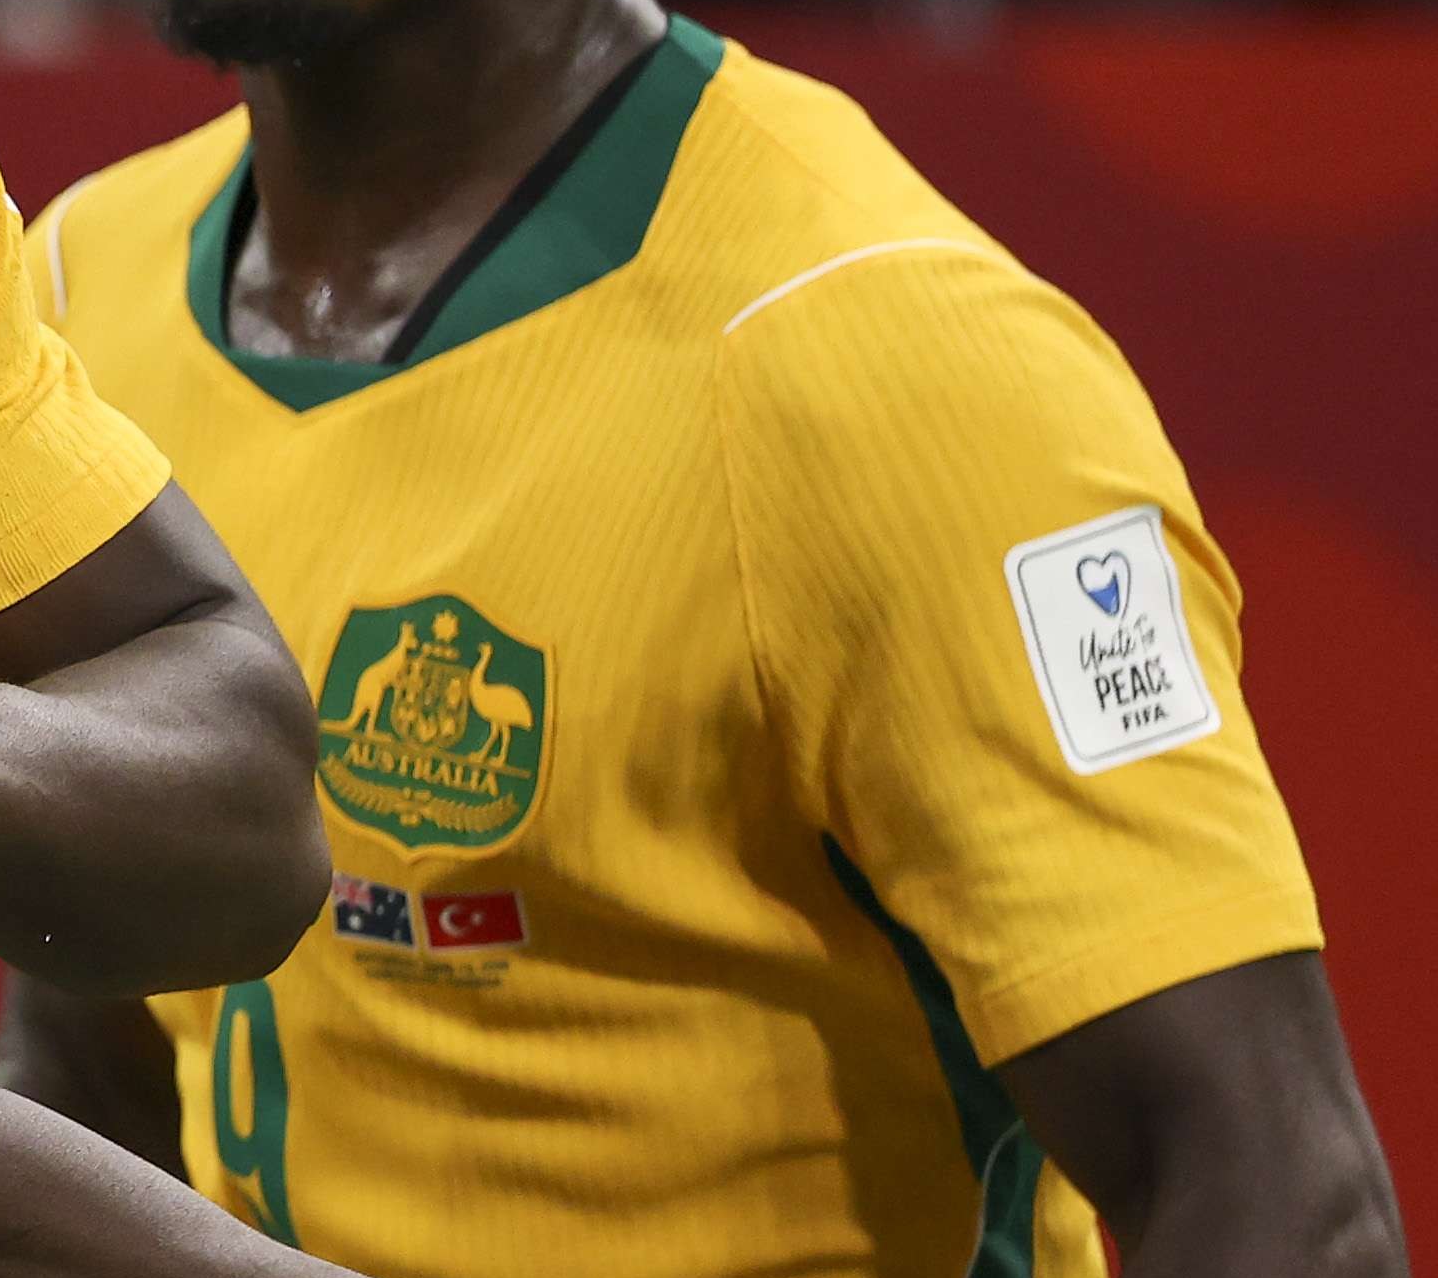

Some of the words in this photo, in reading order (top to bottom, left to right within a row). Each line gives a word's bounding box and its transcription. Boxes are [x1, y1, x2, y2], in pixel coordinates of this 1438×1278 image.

[1094, 656, 1173, 711] PEACE
[1122, 703, 1169, 732] FIFA
[342, 740, 500, 797] AUSTRALIA
